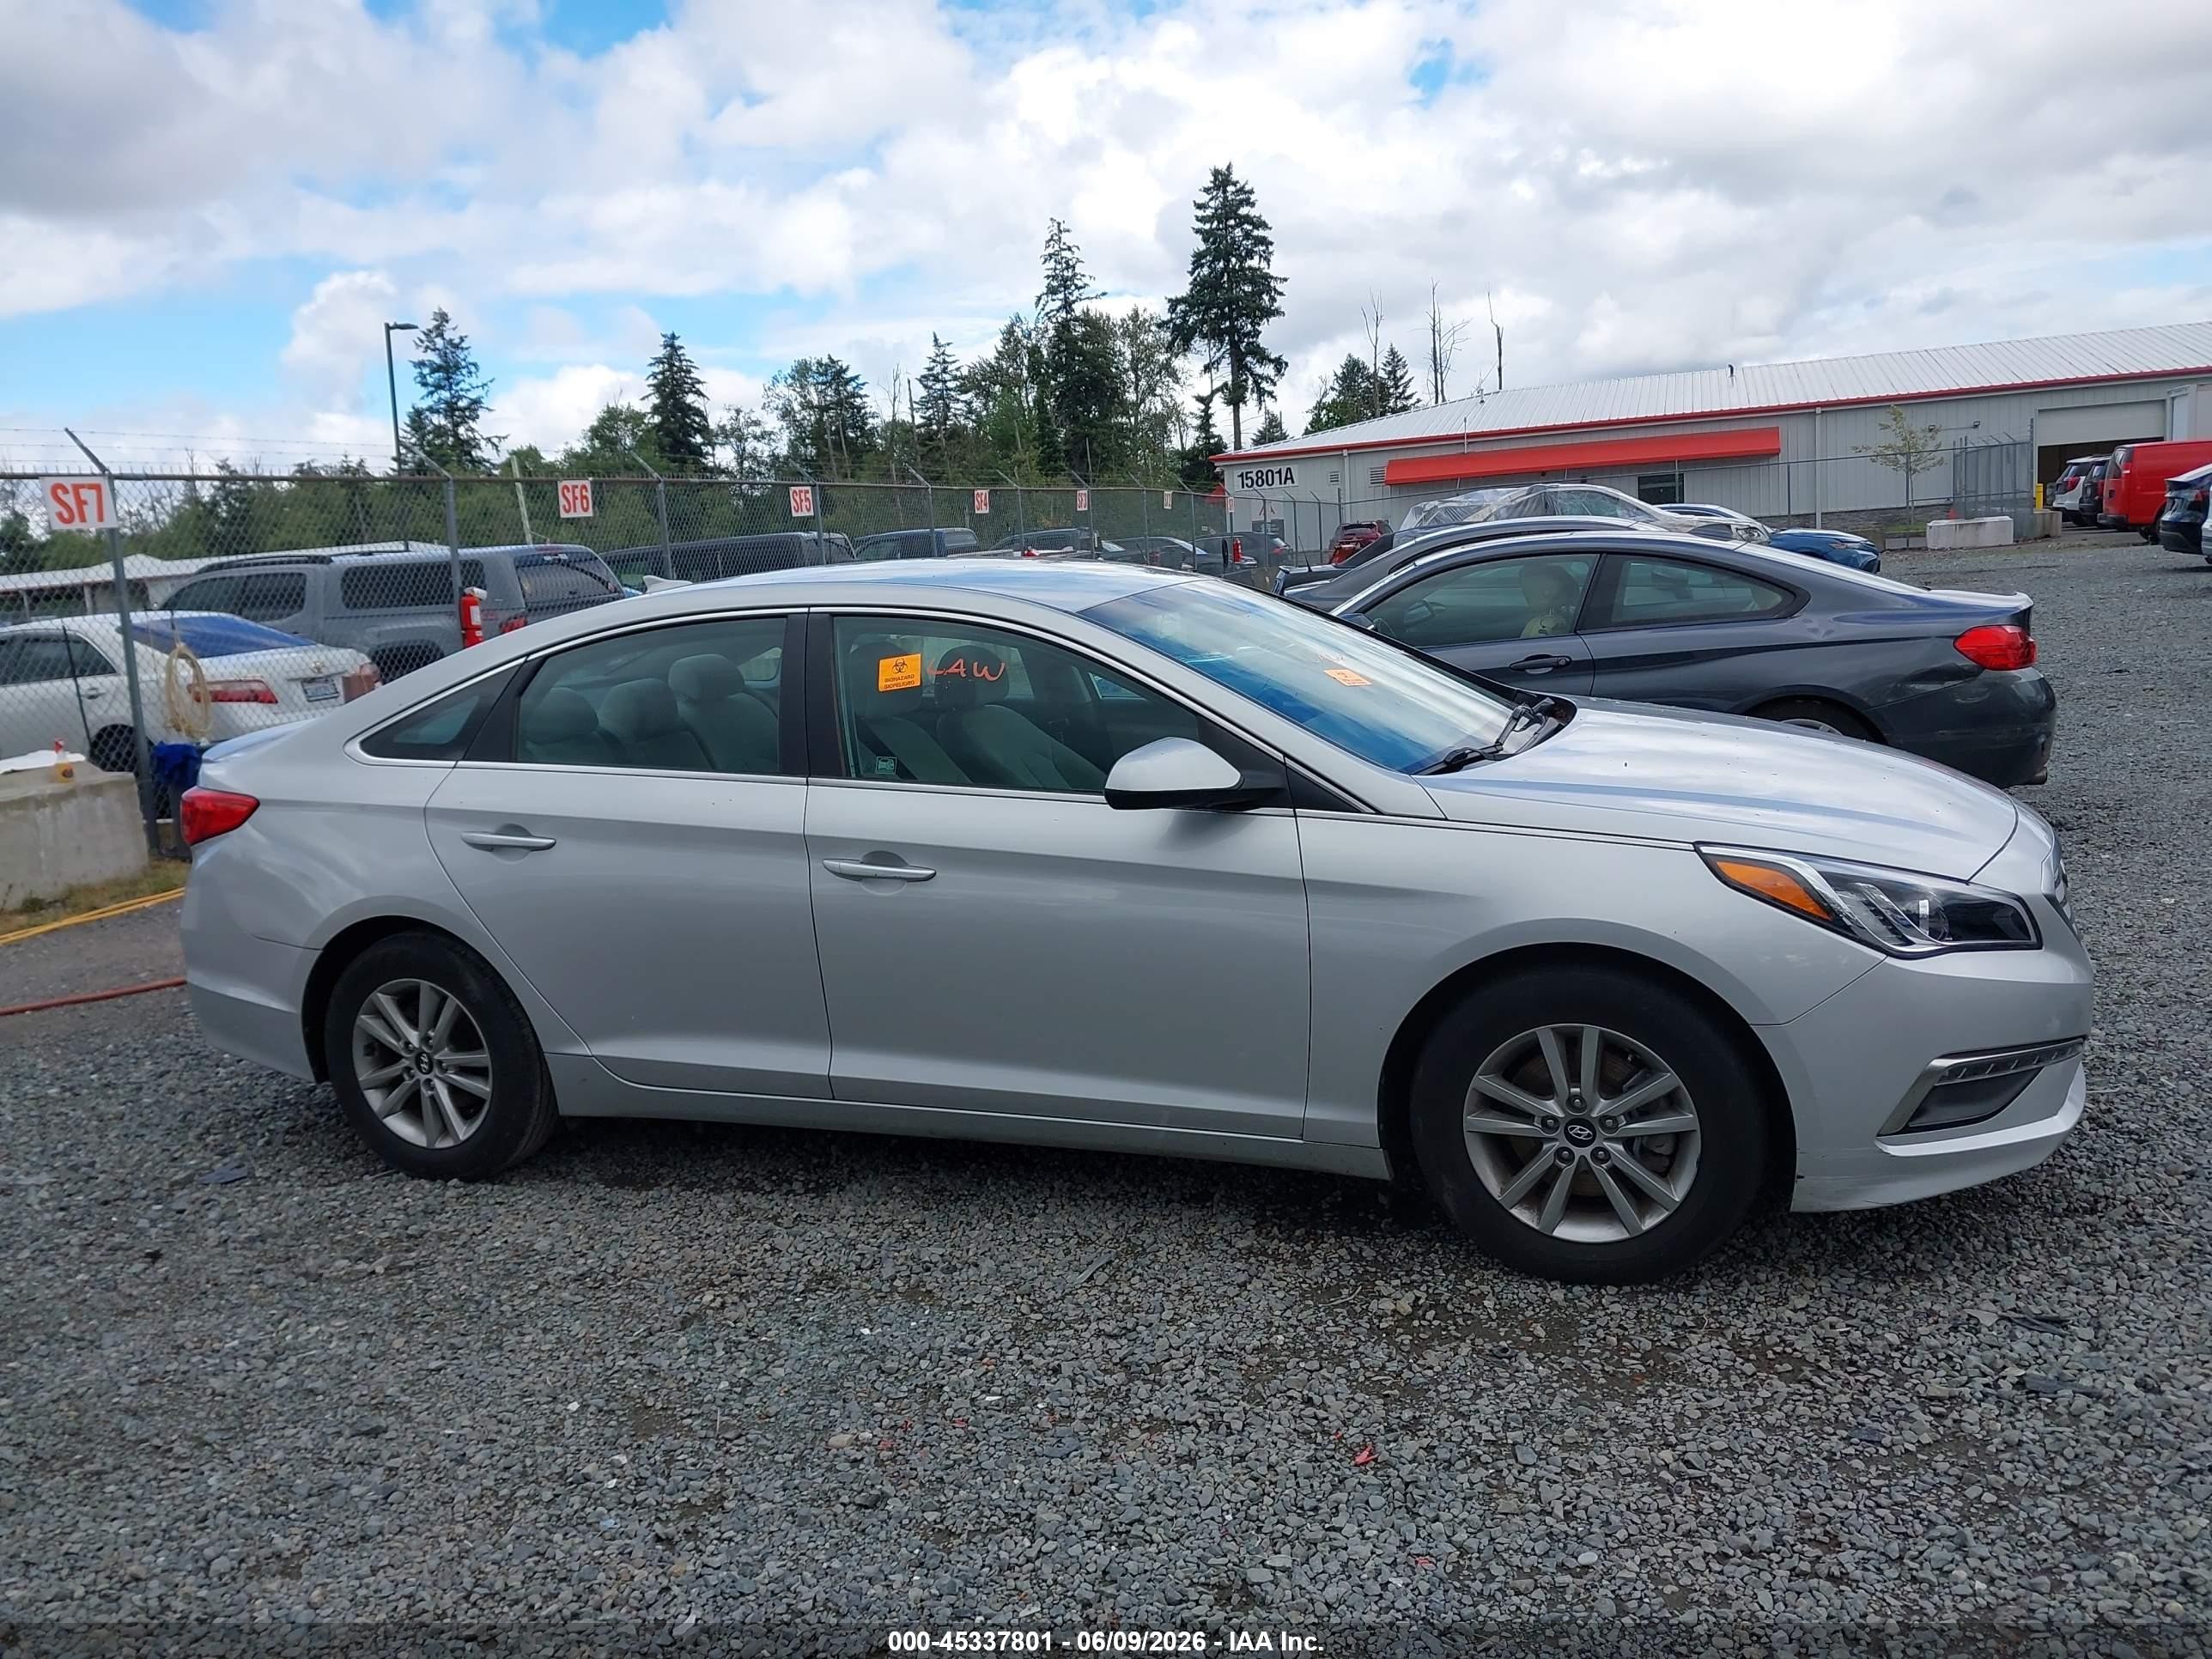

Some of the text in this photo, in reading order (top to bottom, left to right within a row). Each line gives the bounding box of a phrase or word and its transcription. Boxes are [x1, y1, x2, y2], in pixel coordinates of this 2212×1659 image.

[1237, 467, 1295, 489] 15801A
[50, 483, 104, 524] SF7
[561, 484, 590, 514] SF6
[792, 489, 811, 513] SF5
[975, 492, 988, 511] SF4
[1078, 492, 1087, 509] SF3
[884, 674, 915, 683] BIOHAZARD
[926, 658, 1006, 681] LAW
